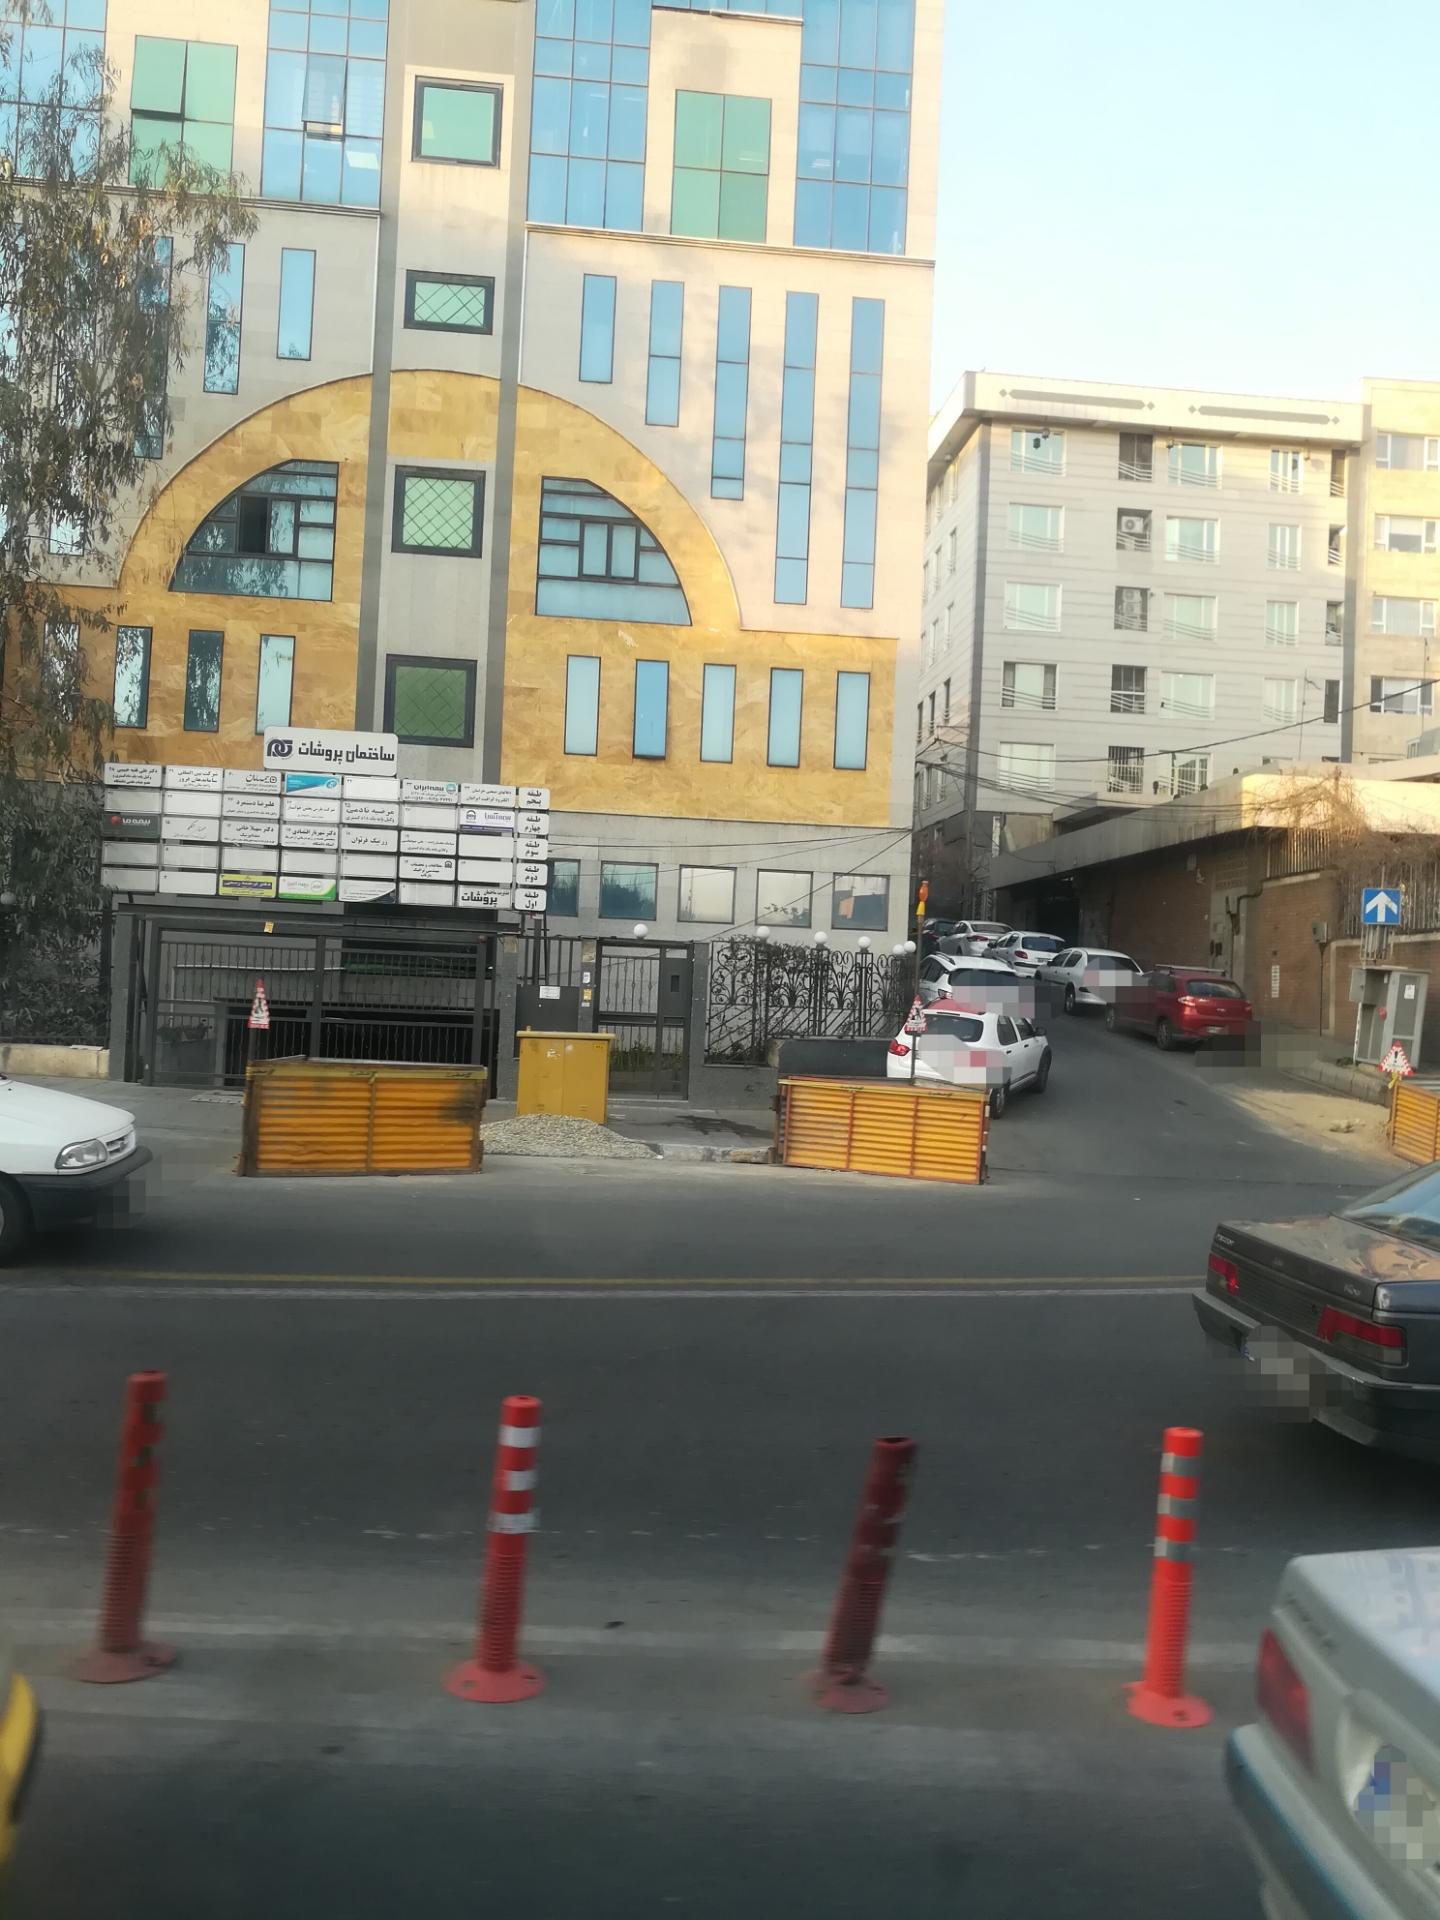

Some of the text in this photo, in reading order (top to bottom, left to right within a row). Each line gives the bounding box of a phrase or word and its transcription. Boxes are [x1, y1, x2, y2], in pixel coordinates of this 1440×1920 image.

[298, 741, 395, 764] ساختمان پروشات
[525, 824, 541, 832] چهارم
[525, 875, 538, 883] دوم
[461, 890, 498, 908] پروشات
[525, 900, 537, 910] اول
